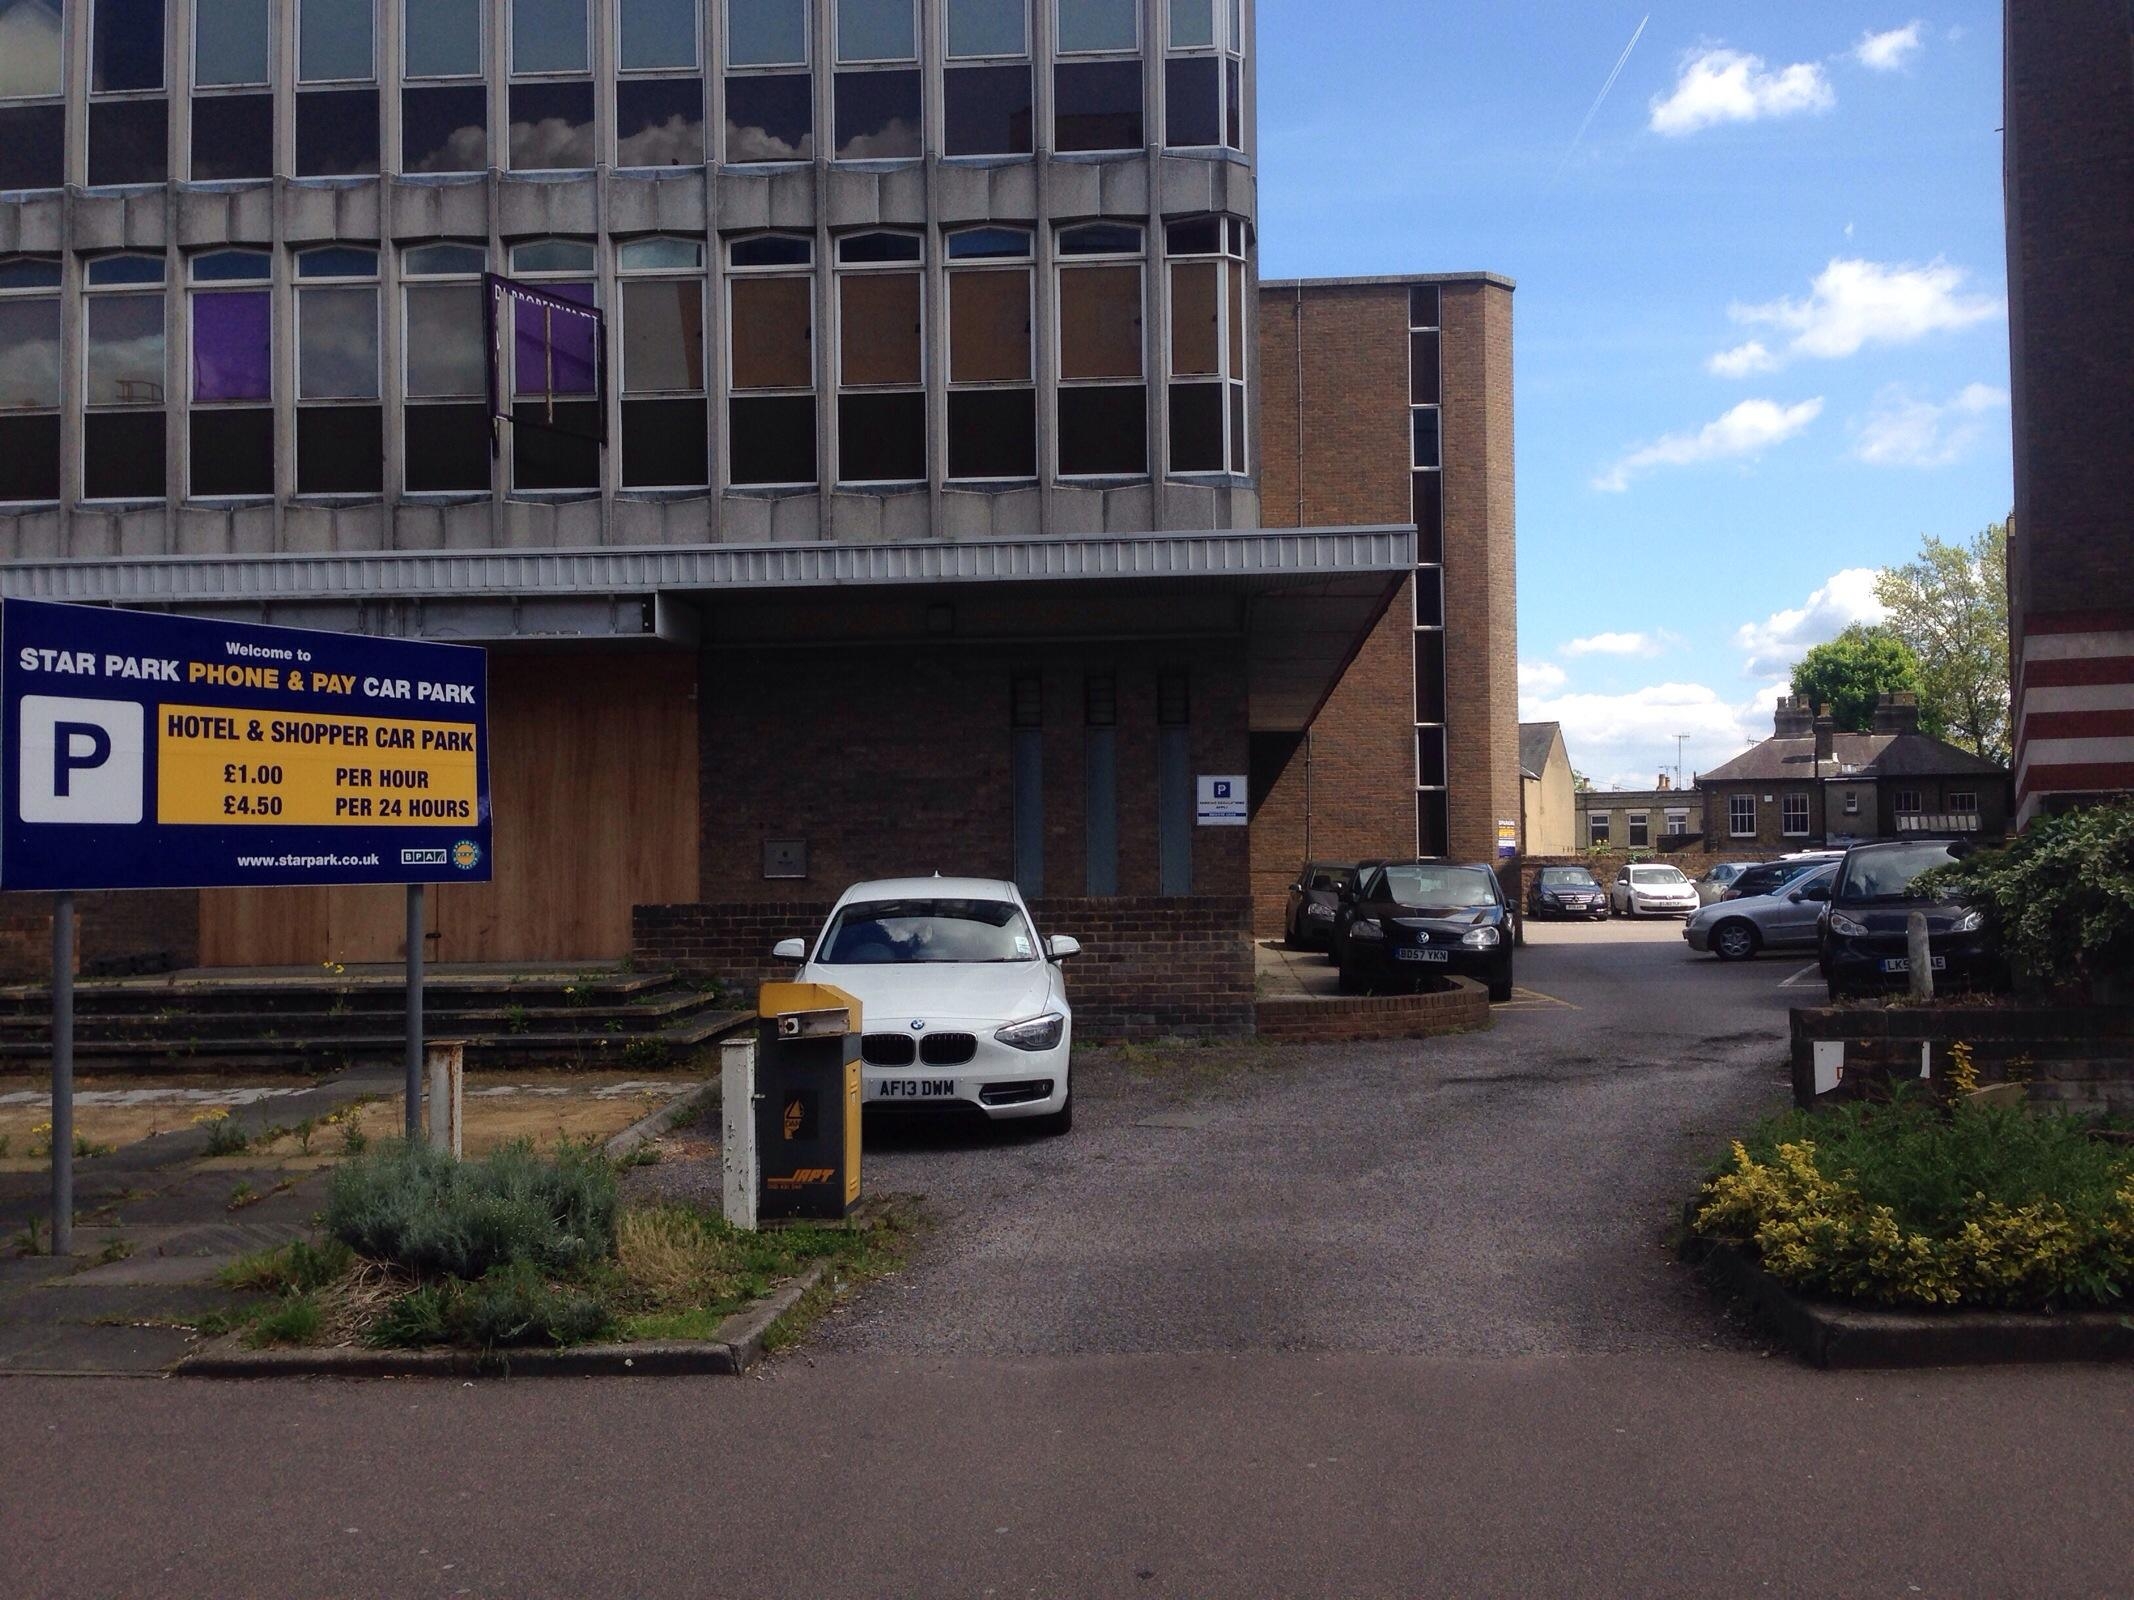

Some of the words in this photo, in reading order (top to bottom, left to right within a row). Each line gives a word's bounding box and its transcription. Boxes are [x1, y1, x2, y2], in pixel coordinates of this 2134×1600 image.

[225, 641, 292, 660] Welcome
[296, 648, 312, 662] to
[19, 647, 96, 675] STAR
[105, 654, 180, 682] PARK
[188, 661, 279, 690] PHONE
[287, 670, 304, 692] &
[312, 672, 357, 695] PAY
[363, 676, 411, 700] CAR
[418, 681, 476, 704] PARK
[168, 714, 240, 740] HOTEL
[247, 719, 264, 742] &
[271, 721, 369, 747] SHOPPER
[375, 727, 415, 750] CAR
[421, 729, 474, 752] PARK
[54, 721, 111, 797] P
[224, 764, 283, 785] £1.00
[336, 767, 372, 787] PER
[379, 769, 429, 788] HOUR
[223, 795, 283, 815] £4.50
[336, 797, 372, 816] PER
[379, 798, 402, 817] 24
[409, 799, 470, 818] HOURS
[237, 853, 379, 869] www.starpark.co.uk
[1887, 959, 1911, 971] LK5
[880, 1080, 917, 1096] AF13
[921, 1079, 955, 1096] DWM
